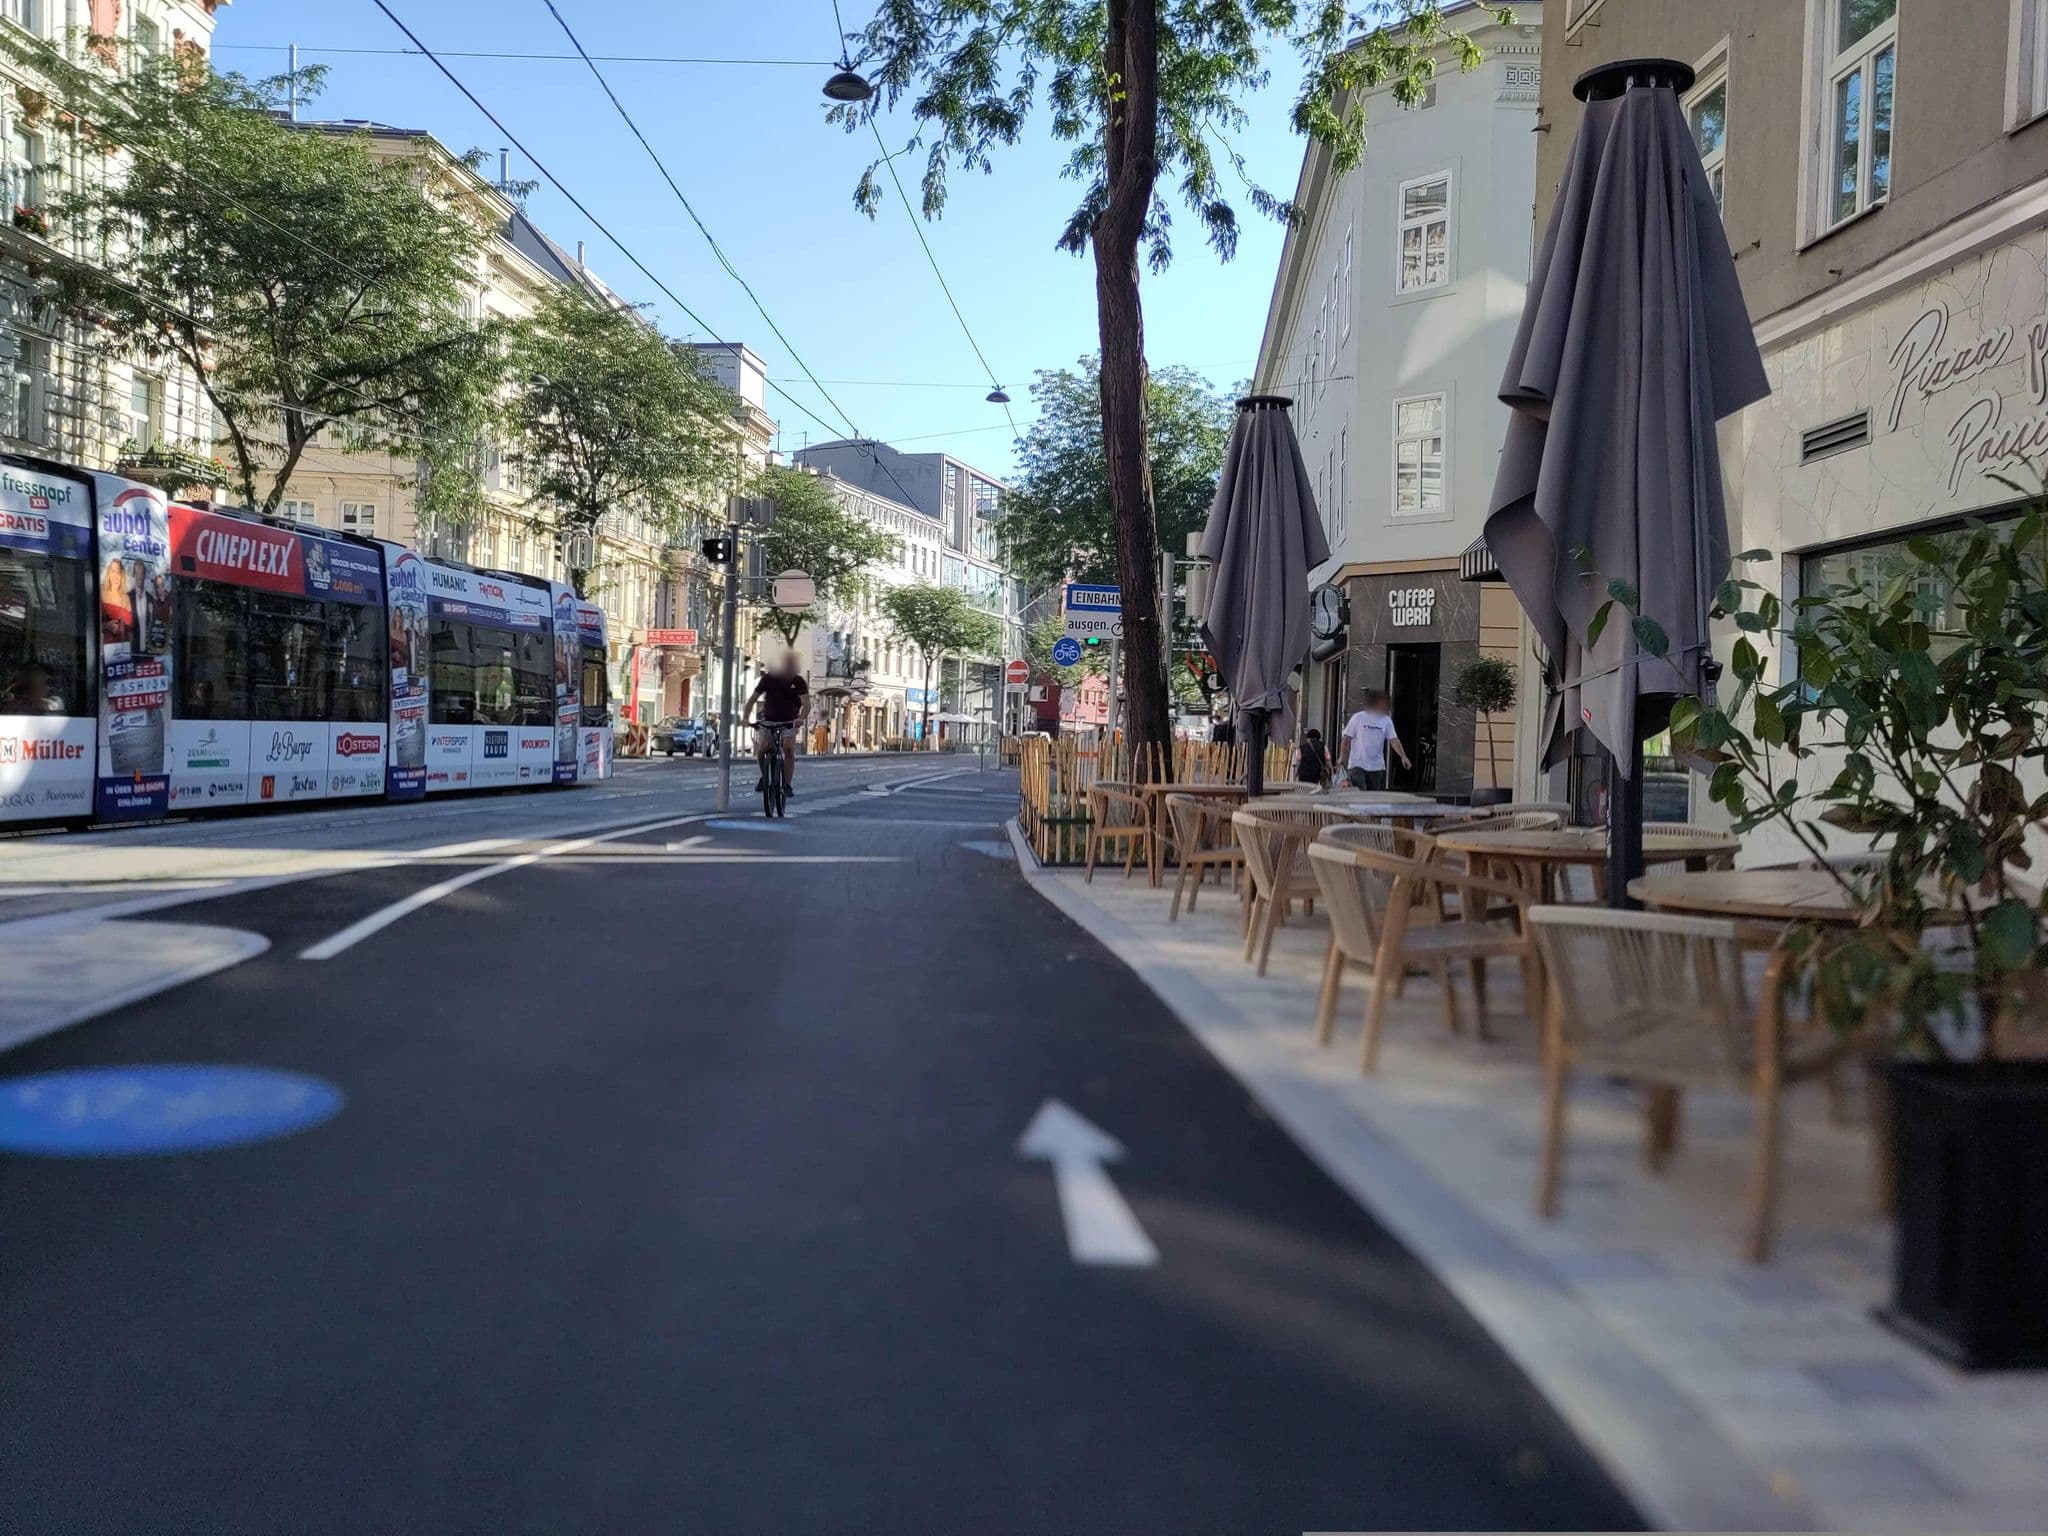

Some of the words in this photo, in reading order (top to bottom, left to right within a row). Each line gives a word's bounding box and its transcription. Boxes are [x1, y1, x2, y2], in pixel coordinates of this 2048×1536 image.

[3, 473, 72, 505] fressnapf
[0, 513, 45, 533] GRATIS
[104, 507, 151, 536] auhof
[124, 537, 167, 557] center
[196, 529, 294, 577] CINEPLEXX
[390, 568, 417, 590] auhof
[432, 571, 468, 592] HUMANIC
[1068, 619, 1110, 633] ausgen.
[107, 663, 135, 677] DEIN
[136, 663, 162, 676] BEST
[110, 679, 166, 694] FASHION
[117, 693, 163, 709] FEELING
[22, 739, 84, 761] Müller
[281, 731, 313, 762] Burger
[436, 736, 468, 746] INTERSPORT
[486, 735, 507, 745] KLEIDER
[521, 739, 550, 749] WOOLWORTH
[289, 776, 317, 797] Justus
